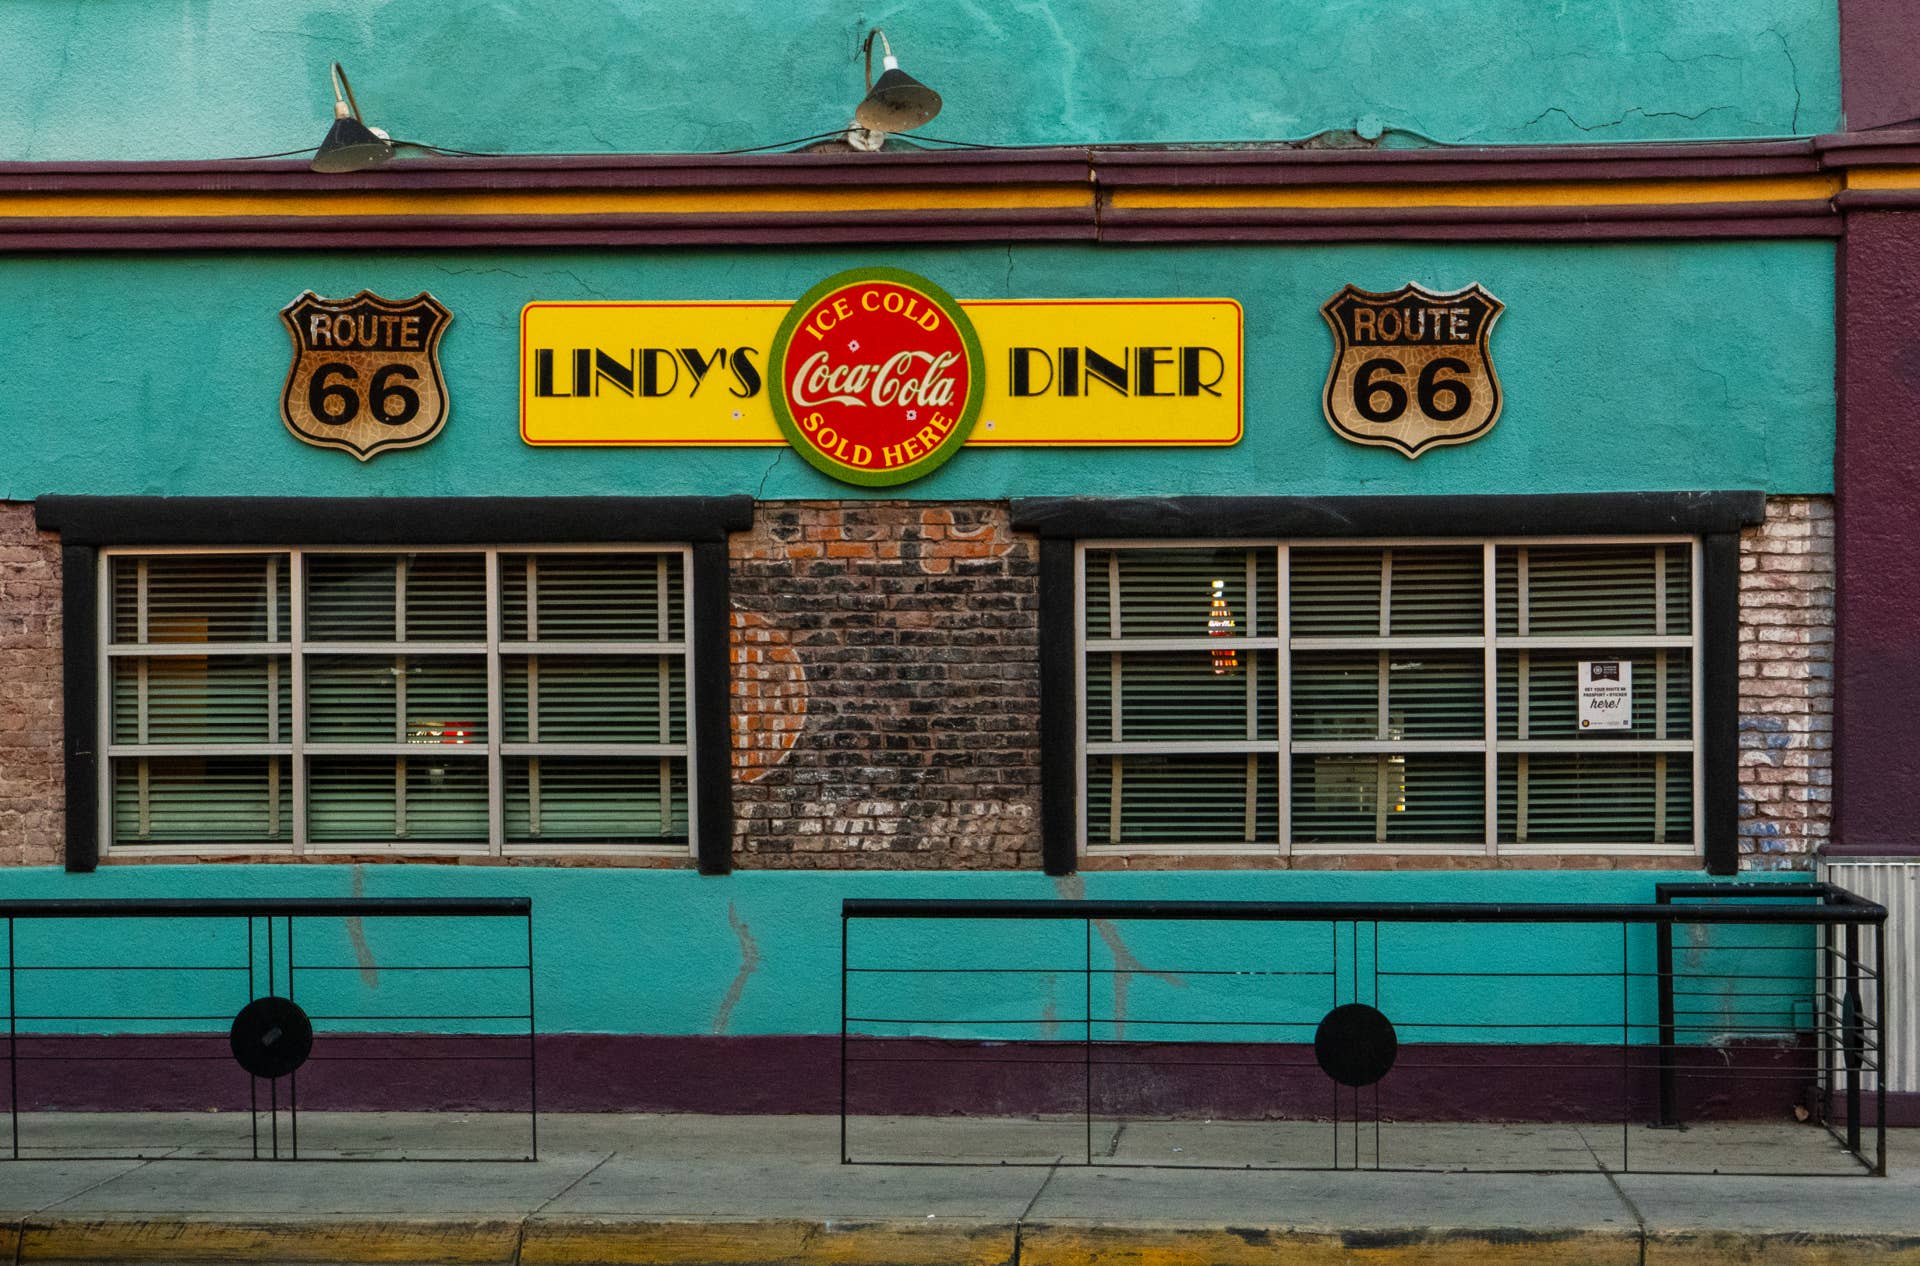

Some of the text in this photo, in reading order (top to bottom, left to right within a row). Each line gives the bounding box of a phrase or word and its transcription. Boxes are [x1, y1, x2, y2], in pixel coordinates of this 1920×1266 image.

[310, 313, 420, 348] ROUTE
[805, 290, 940, 340] ICE COLD
[1353, 307, 1471, 341] ROUTE
[308, 363, 420, 426] 66
[535, 346, 1224, 398] LINDY'S DINER
[791, 350, 962, 407] Coca-Cola
[1353, 357, 1472, 423] 66
[803, 411, 953, 467] SOLD HERE
[1590, 697, 1621, 709] here!
